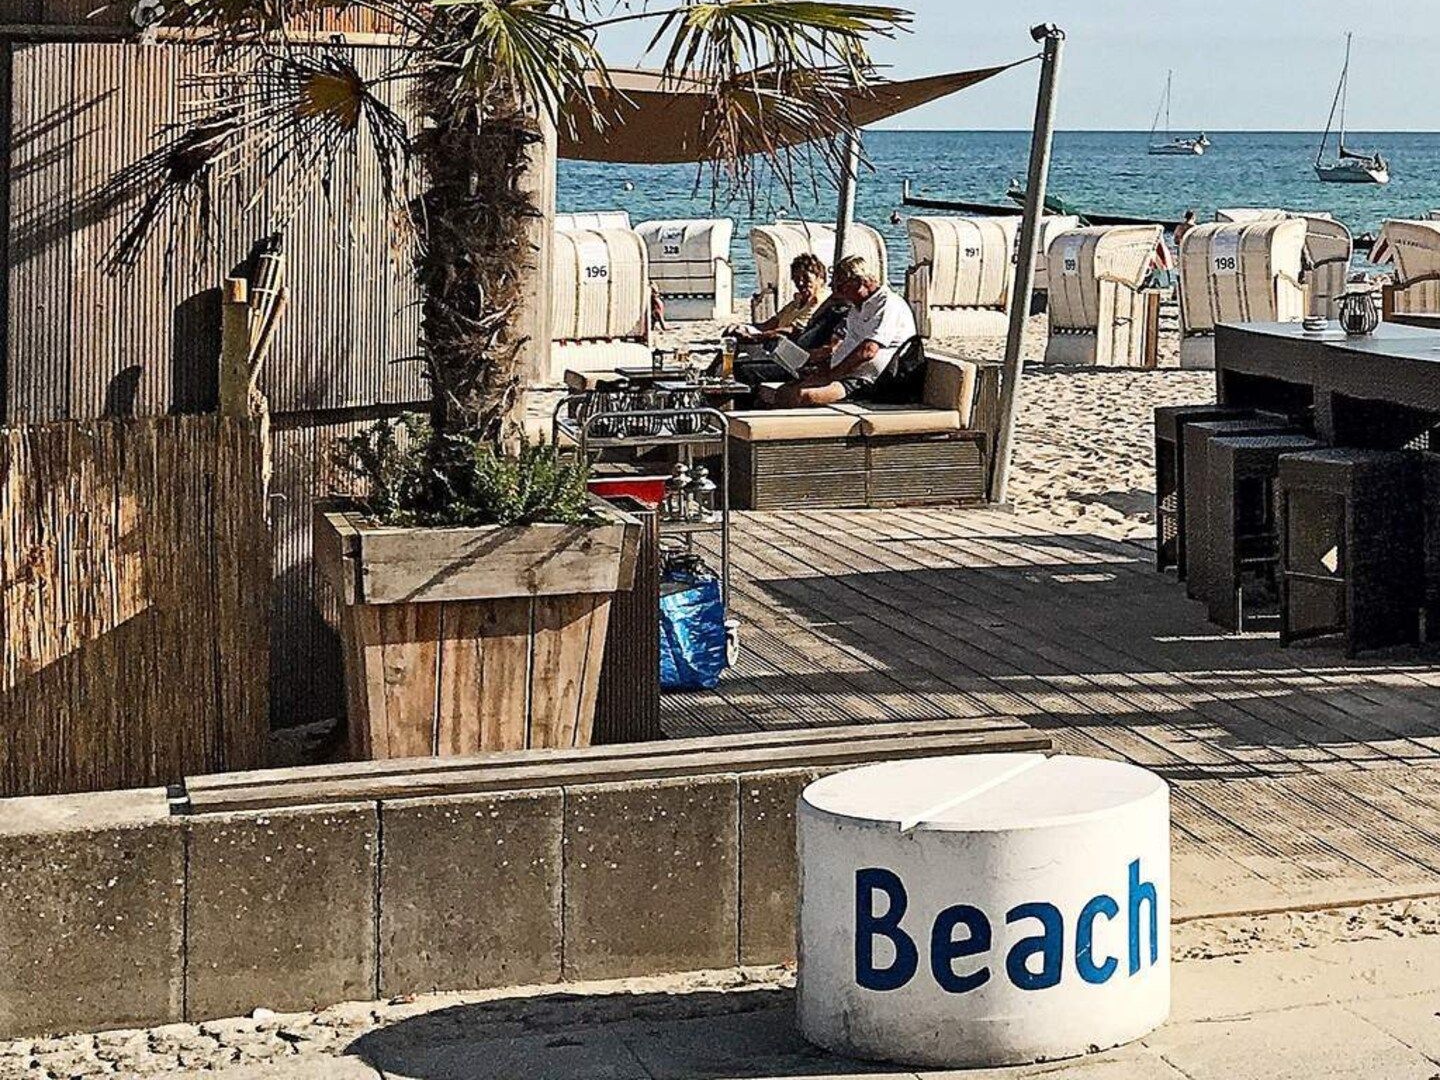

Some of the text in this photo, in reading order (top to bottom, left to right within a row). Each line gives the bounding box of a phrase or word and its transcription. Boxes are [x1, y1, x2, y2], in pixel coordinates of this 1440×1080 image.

[1214, 256, 1236, 270] 198
[585, 265, 608, 278] 196
[854, 856, 1159, 994] Beach
